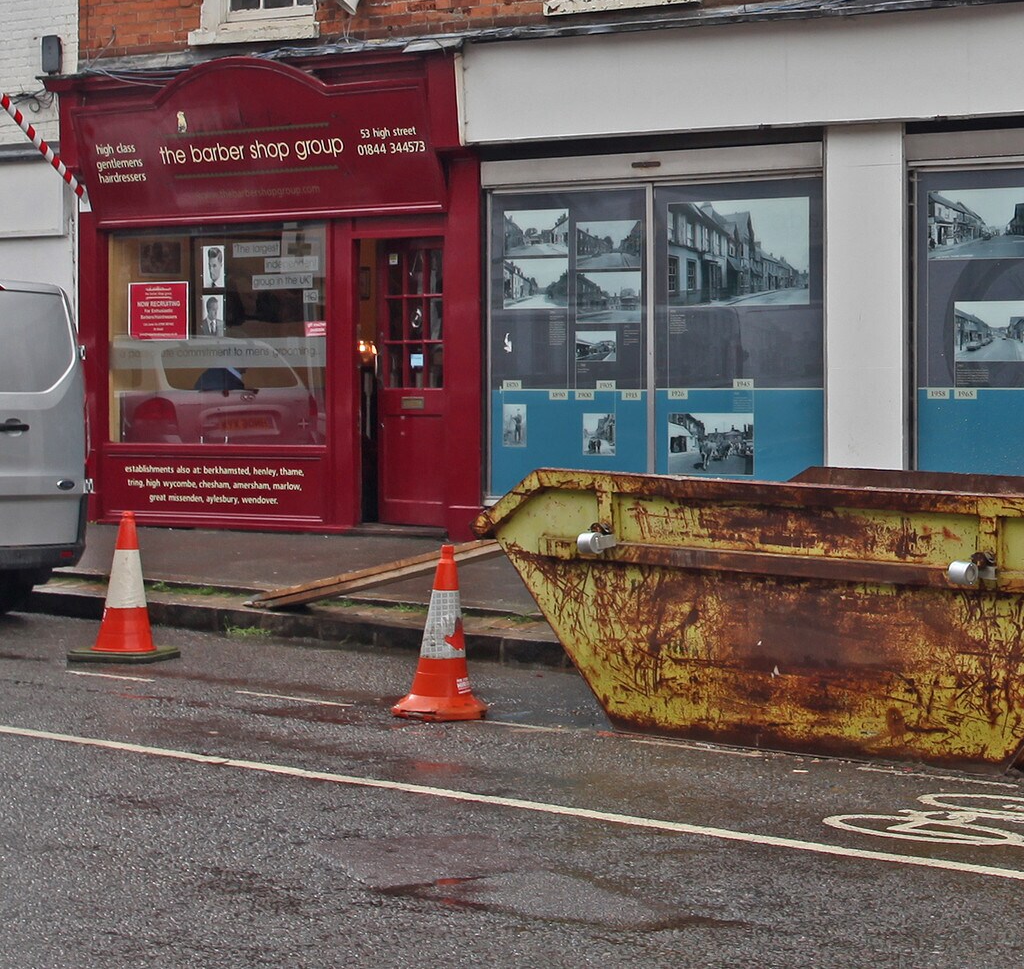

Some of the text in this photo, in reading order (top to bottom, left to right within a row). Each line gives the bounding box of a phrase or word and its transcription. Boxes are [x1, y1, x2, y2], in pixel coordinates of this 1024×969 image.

[360, 126, 417, 140] 53 high street
[95, 142, 136, 158] high class
[159, 136, 345, 165] the barber shop group
[357, 140, 426, 156] 01844 344573
[96, 157, 144, 172] gentlemens
[98, 171, 147, 184] hairdressers
[176, 346, 232, 357] commitment
[233, 346, 243, 357] to
[245, 347, 269, 356] mens
[124, 465, 174, 474] establishments
[176, 465, 191, 474] also
[203, 465, 251, 476] berkhamsted,
[252, 466, 279, 477] henley,
[279, 467, 305, 477] thame,
[127, 478, 302, 491] tring, high wycombe, chesham, amersham, marlow,
[149, 493, 167, 503] great
[168, 493, 204, 504] missenden,
[206, 494, 240, 505] aylesbury,
